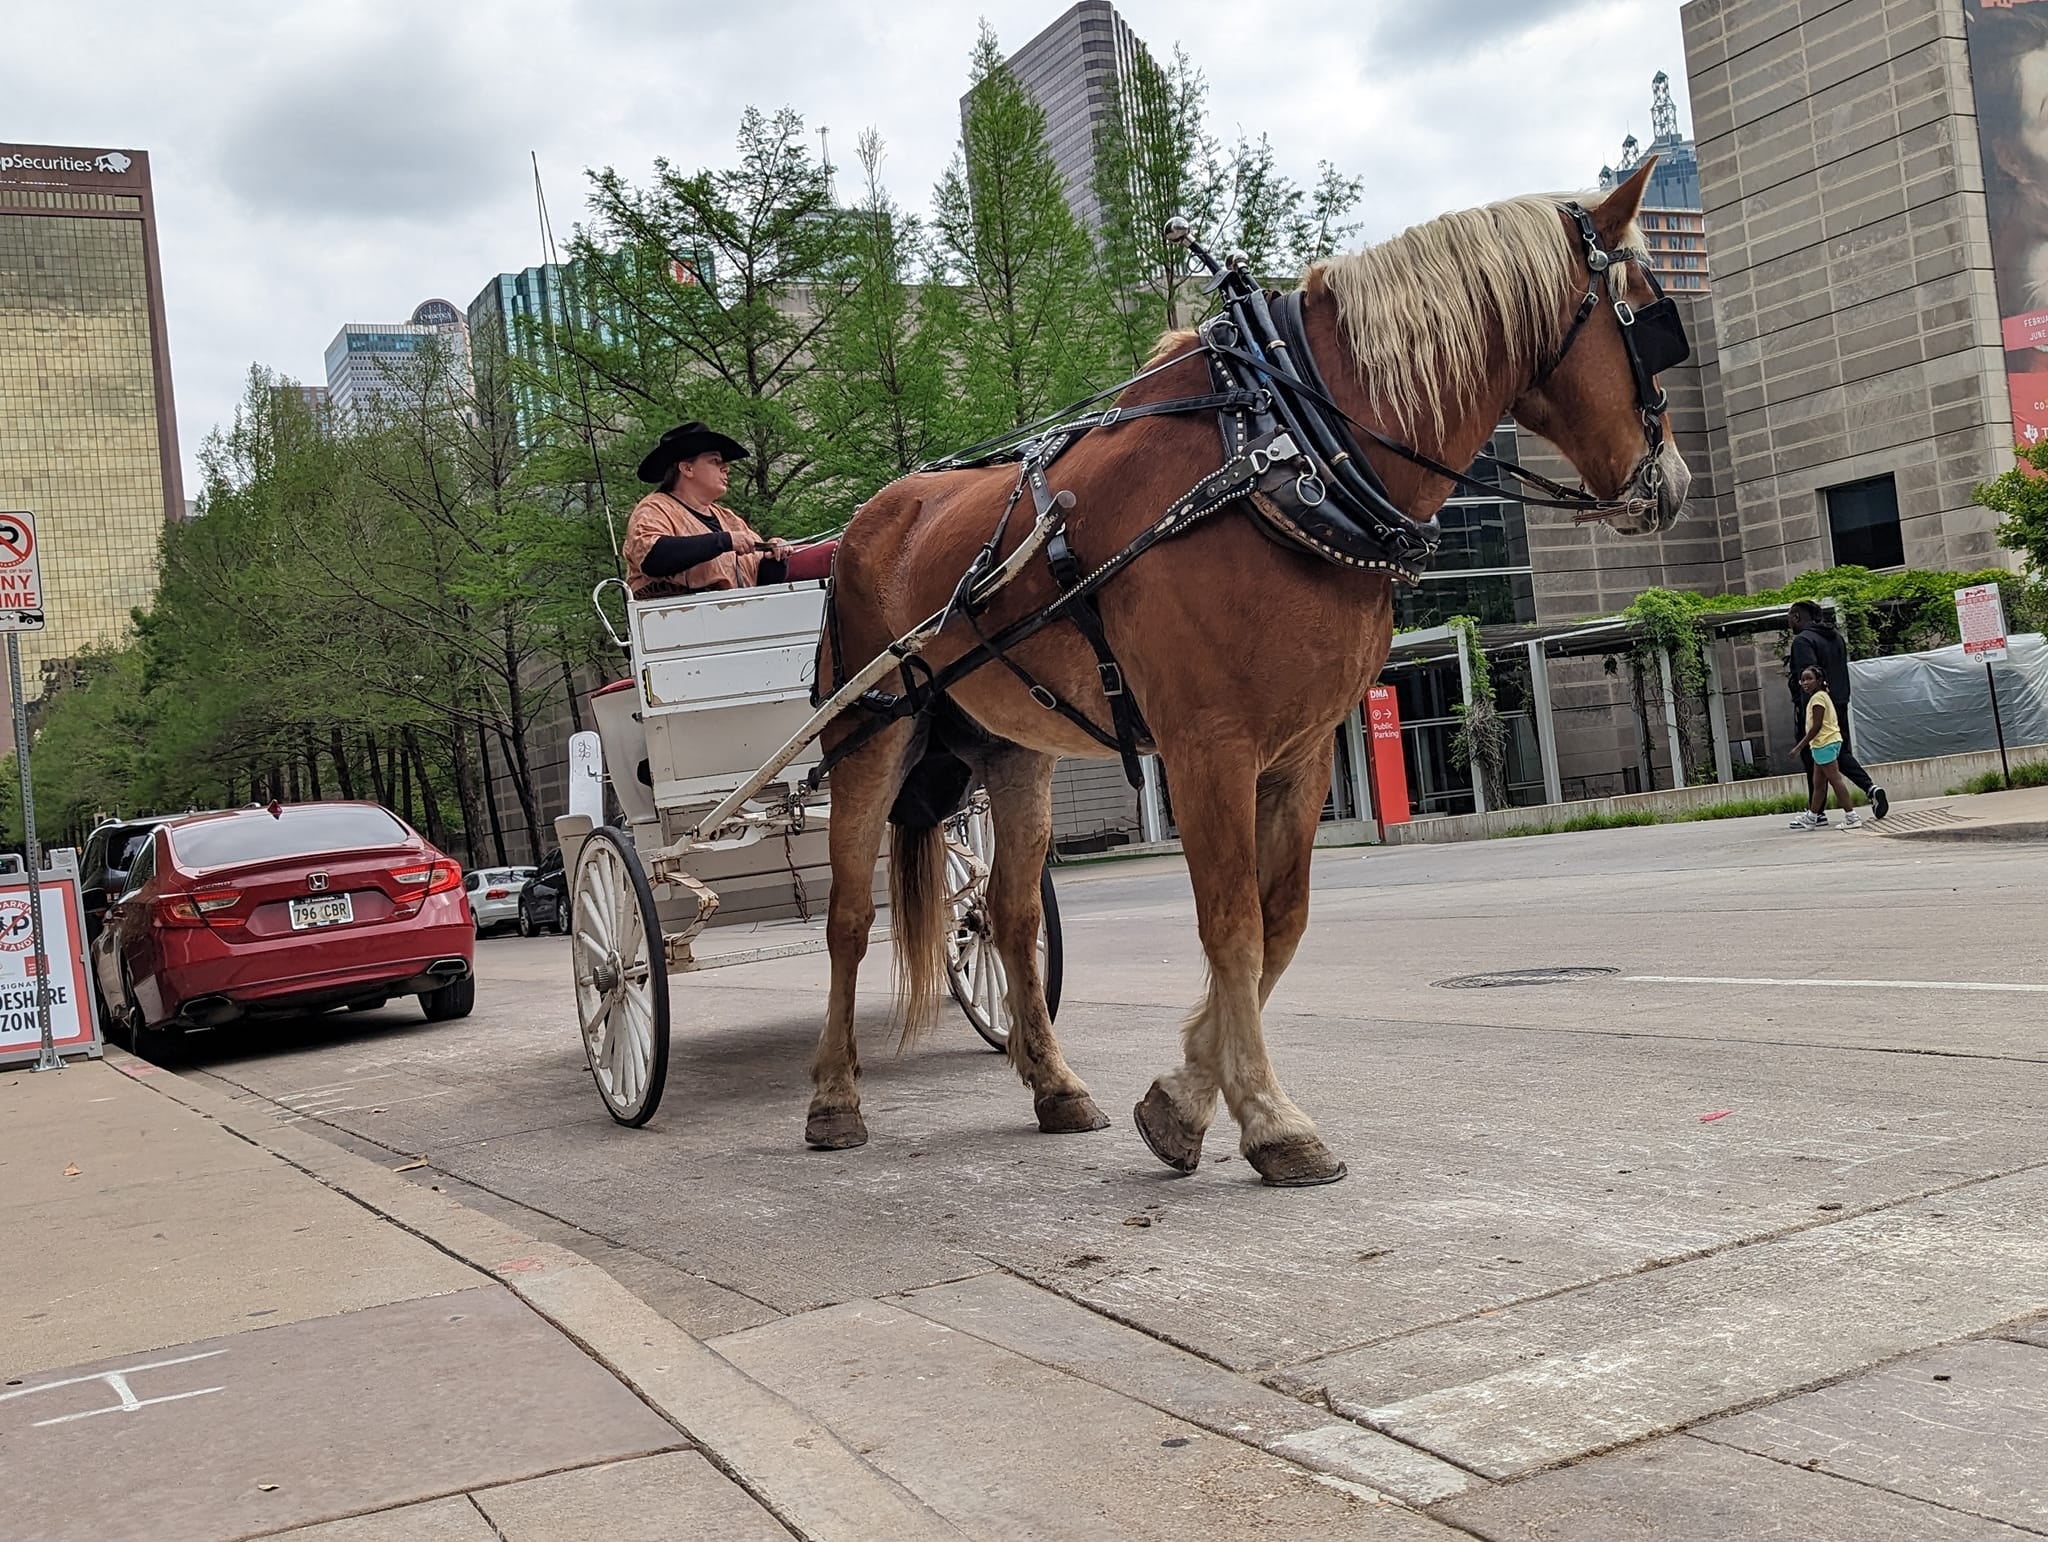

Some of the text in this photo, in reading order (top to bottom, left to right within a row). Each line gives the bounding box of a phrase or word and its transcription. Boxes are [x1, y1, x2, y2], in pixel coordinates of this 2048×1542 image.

[0, 154, 93, 172] pSecurities
[2030, 329, 2046, 341] JUNE
[1370, 689, 1388, 699] DMA
[1373, 722, 1393, 730] Public
[1374, 731, 1399, 739] Parking
[294, 902, 347, 922] 796 CBR
[0, 980, 51, 990] SIGNATD
